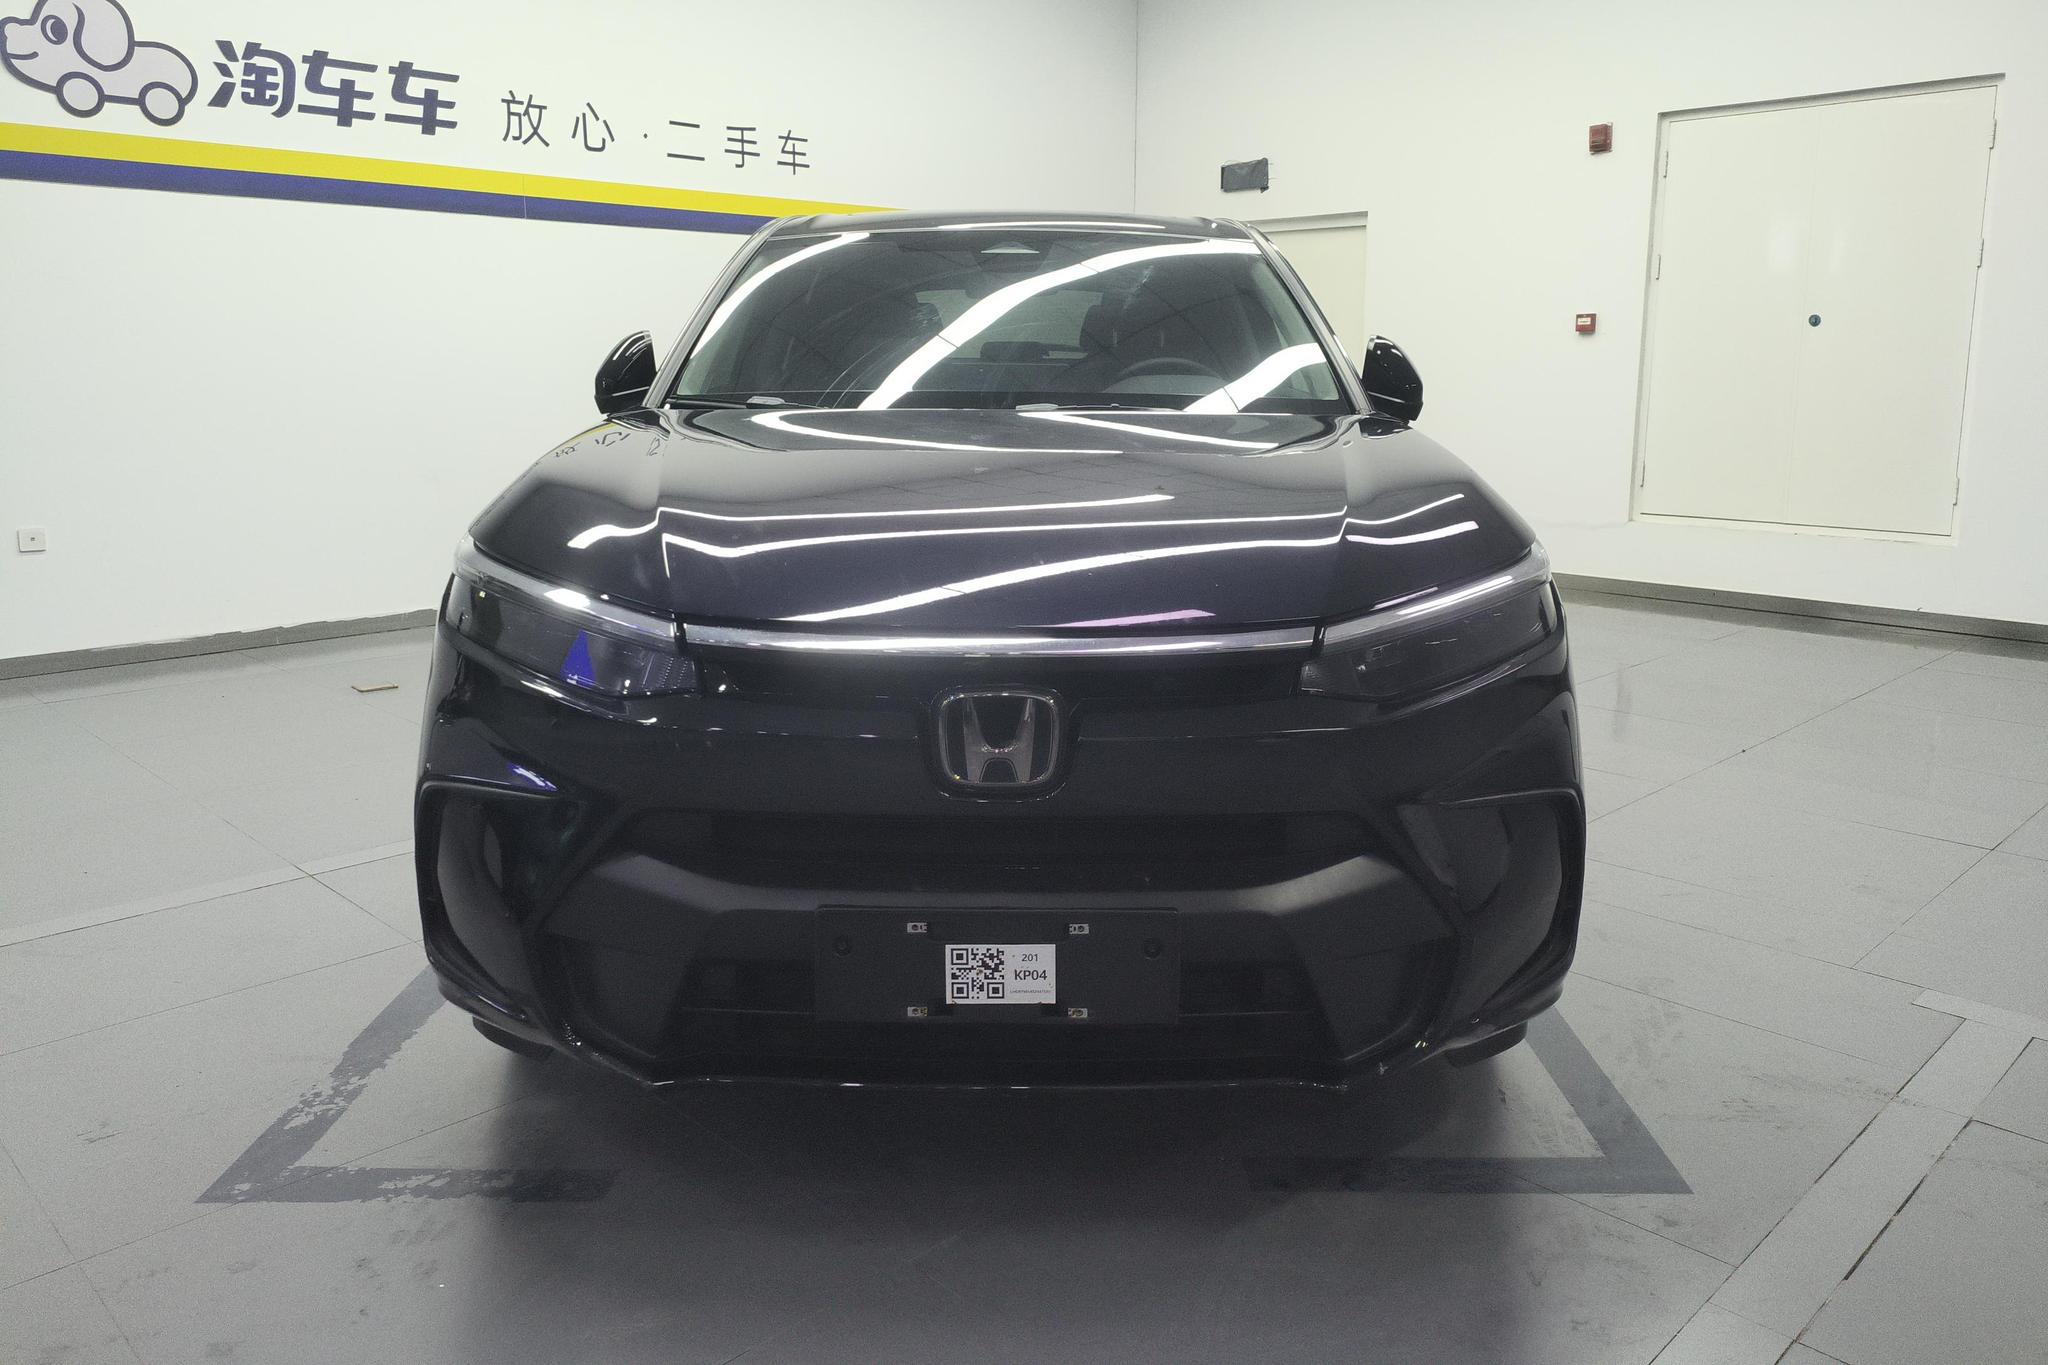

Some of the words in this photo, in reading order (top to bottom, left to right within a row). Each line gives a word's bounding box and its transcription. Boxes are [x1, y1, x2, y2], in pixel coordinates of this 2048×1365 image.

[207, 39, 460, 136] 淘车车
[1021, 953, 1038, 962] 201
[1014, 969, 1048, 981] KP04
